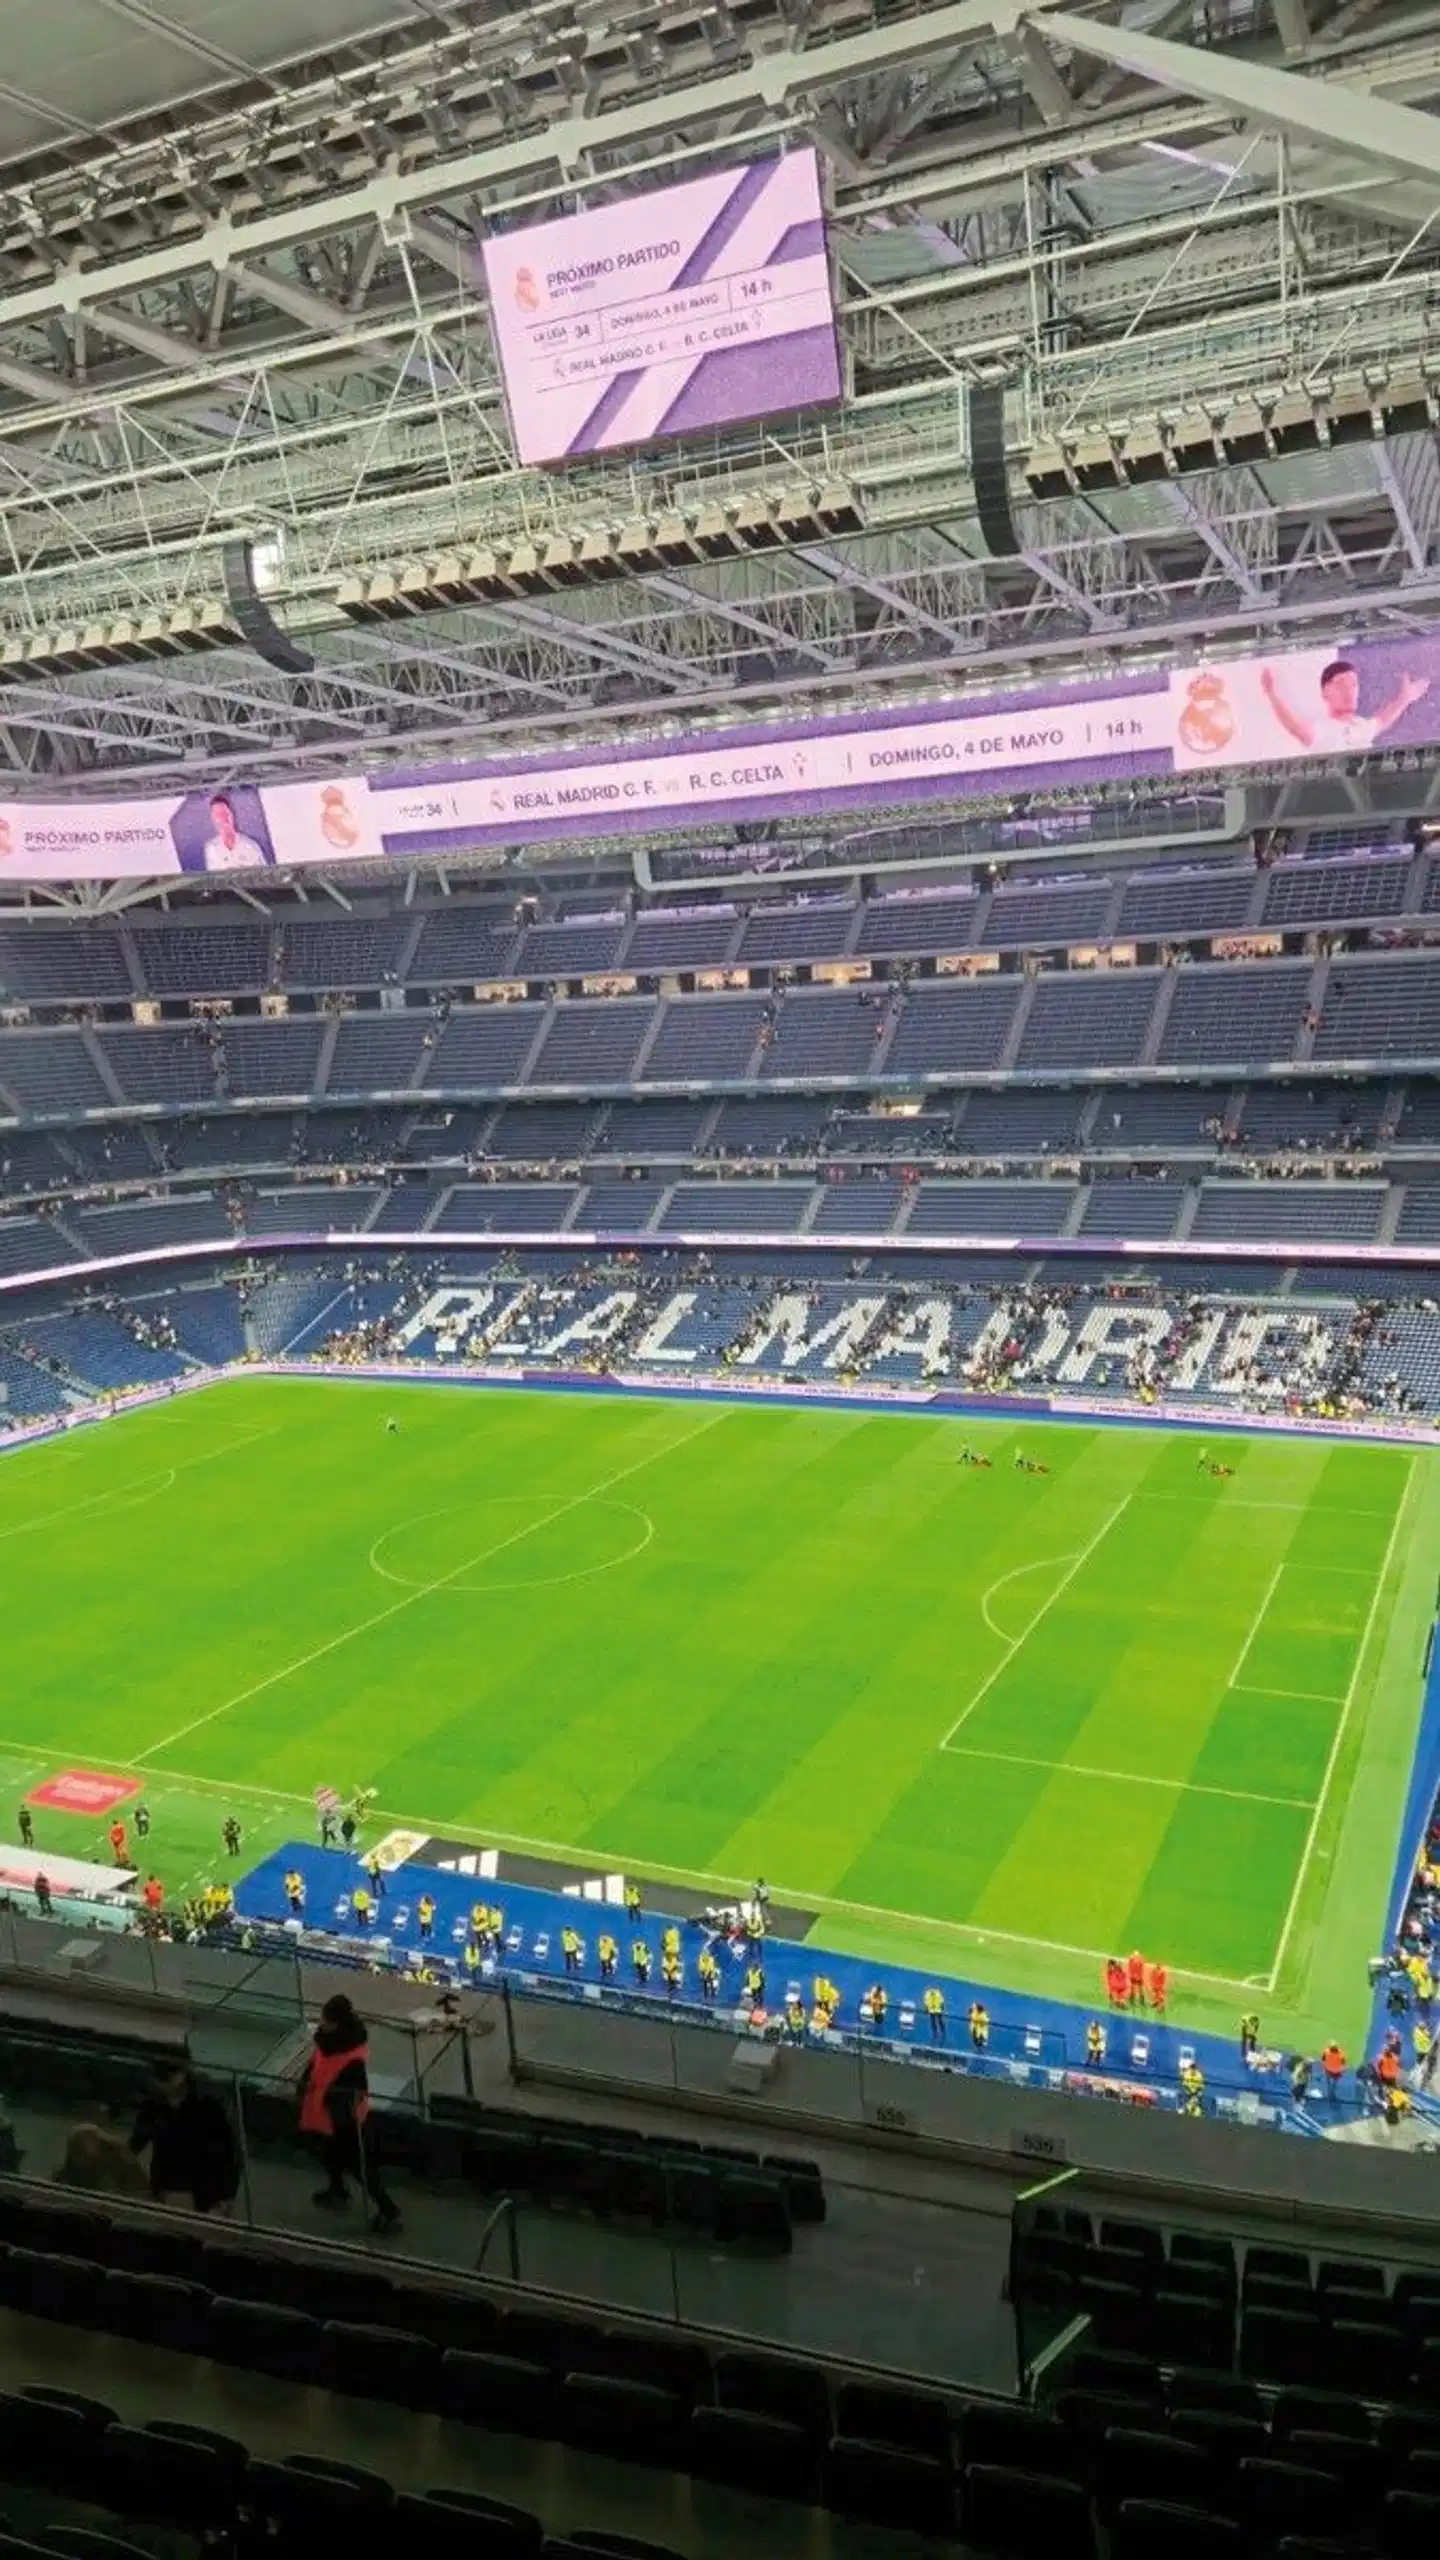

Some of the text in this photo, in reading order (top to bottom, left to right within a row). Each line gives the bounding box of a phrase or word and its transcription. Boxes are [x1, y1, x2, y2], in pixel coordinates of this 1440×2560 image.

[617, 240, 681, 270] PARTIDO
[740, 281, 758, 298] 14
[574, 323, 590, 339] 34
[1106, 722, 1126, 739] 14
[964, 740, 975, 755] 4
[980, 737, 1004, 755] DE
[1010, 729, 1064, 751] MAYO
[731, 764, 784, 785] CELTA
[513, 790, 554, 809] REAL
[556, 784, 620, 806] MADRID
[103, 827, 166, 842] PARTIDO
[399, 1288, 1334, 1397] REAL MADRID
